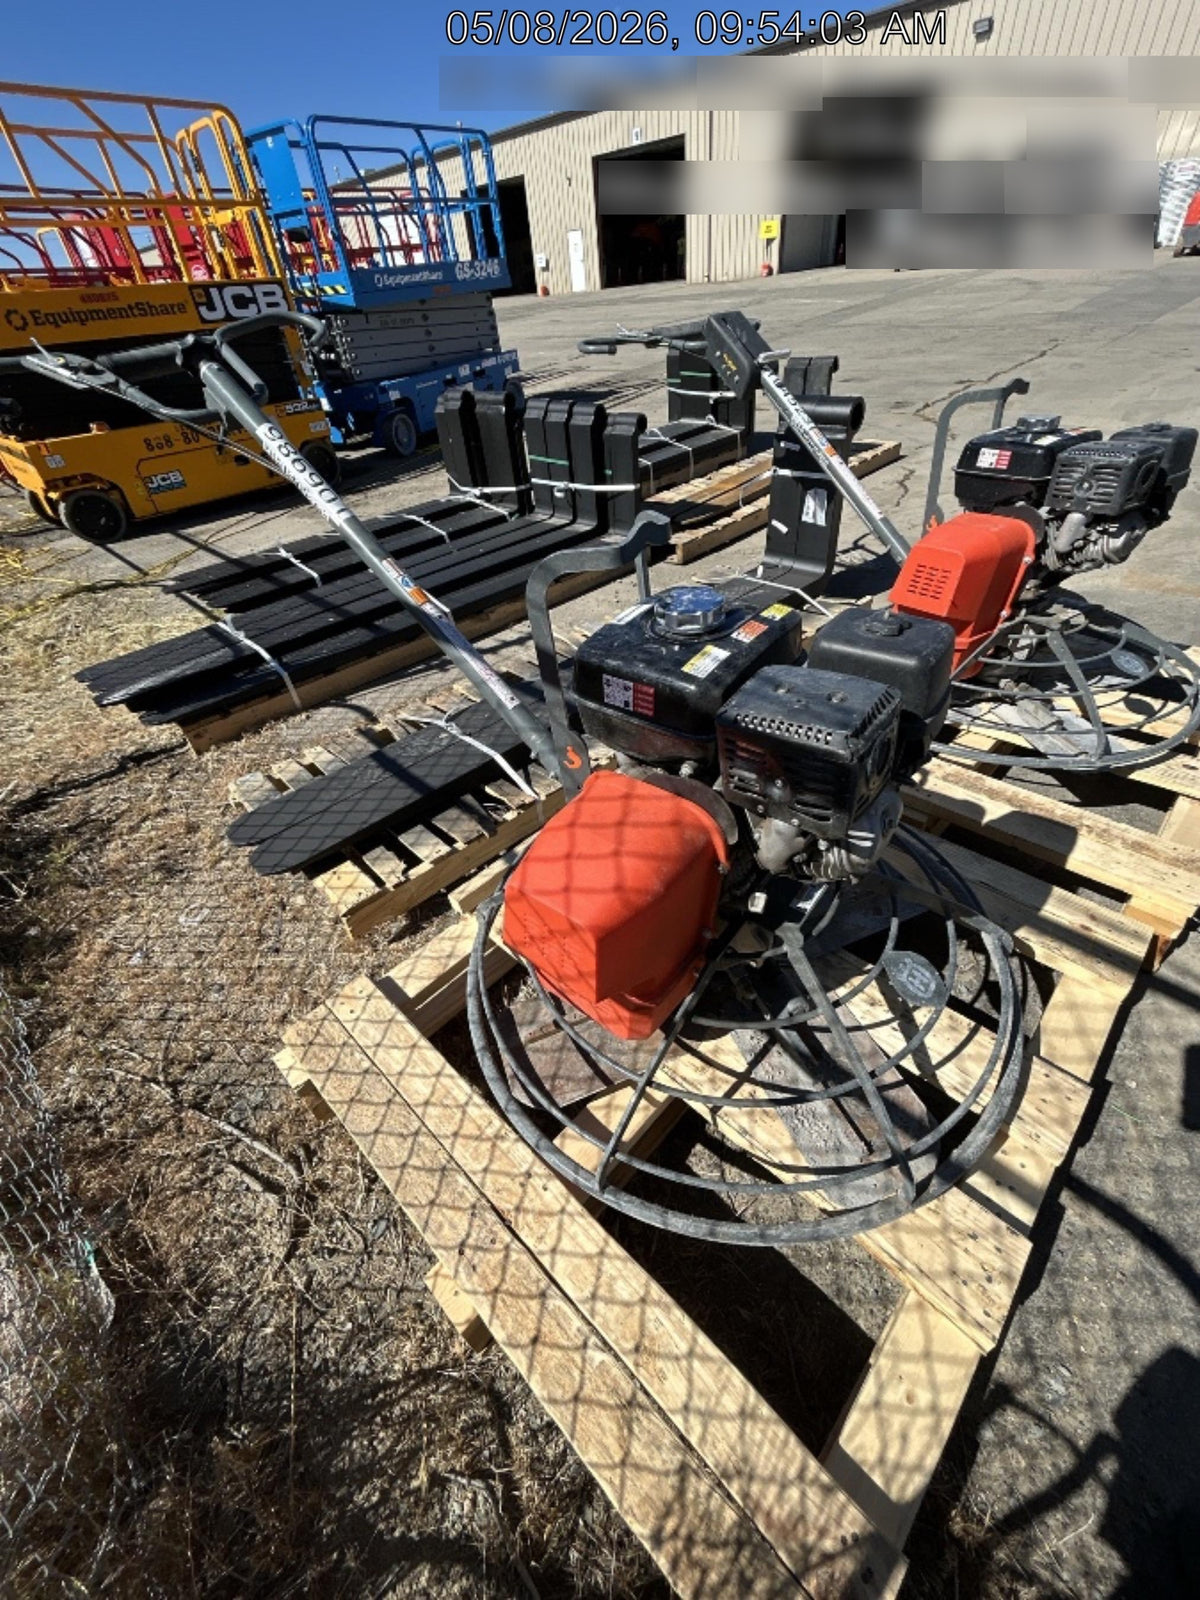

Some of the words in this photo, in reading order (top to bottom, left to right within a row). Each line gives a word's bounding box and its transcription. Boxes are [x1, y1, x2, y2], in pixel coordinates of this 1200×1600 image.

[29, 301, 187, 328] EquipmentShare
[198, 284, 289, 321] JCB
[147, 471, 184, 488] JCB
